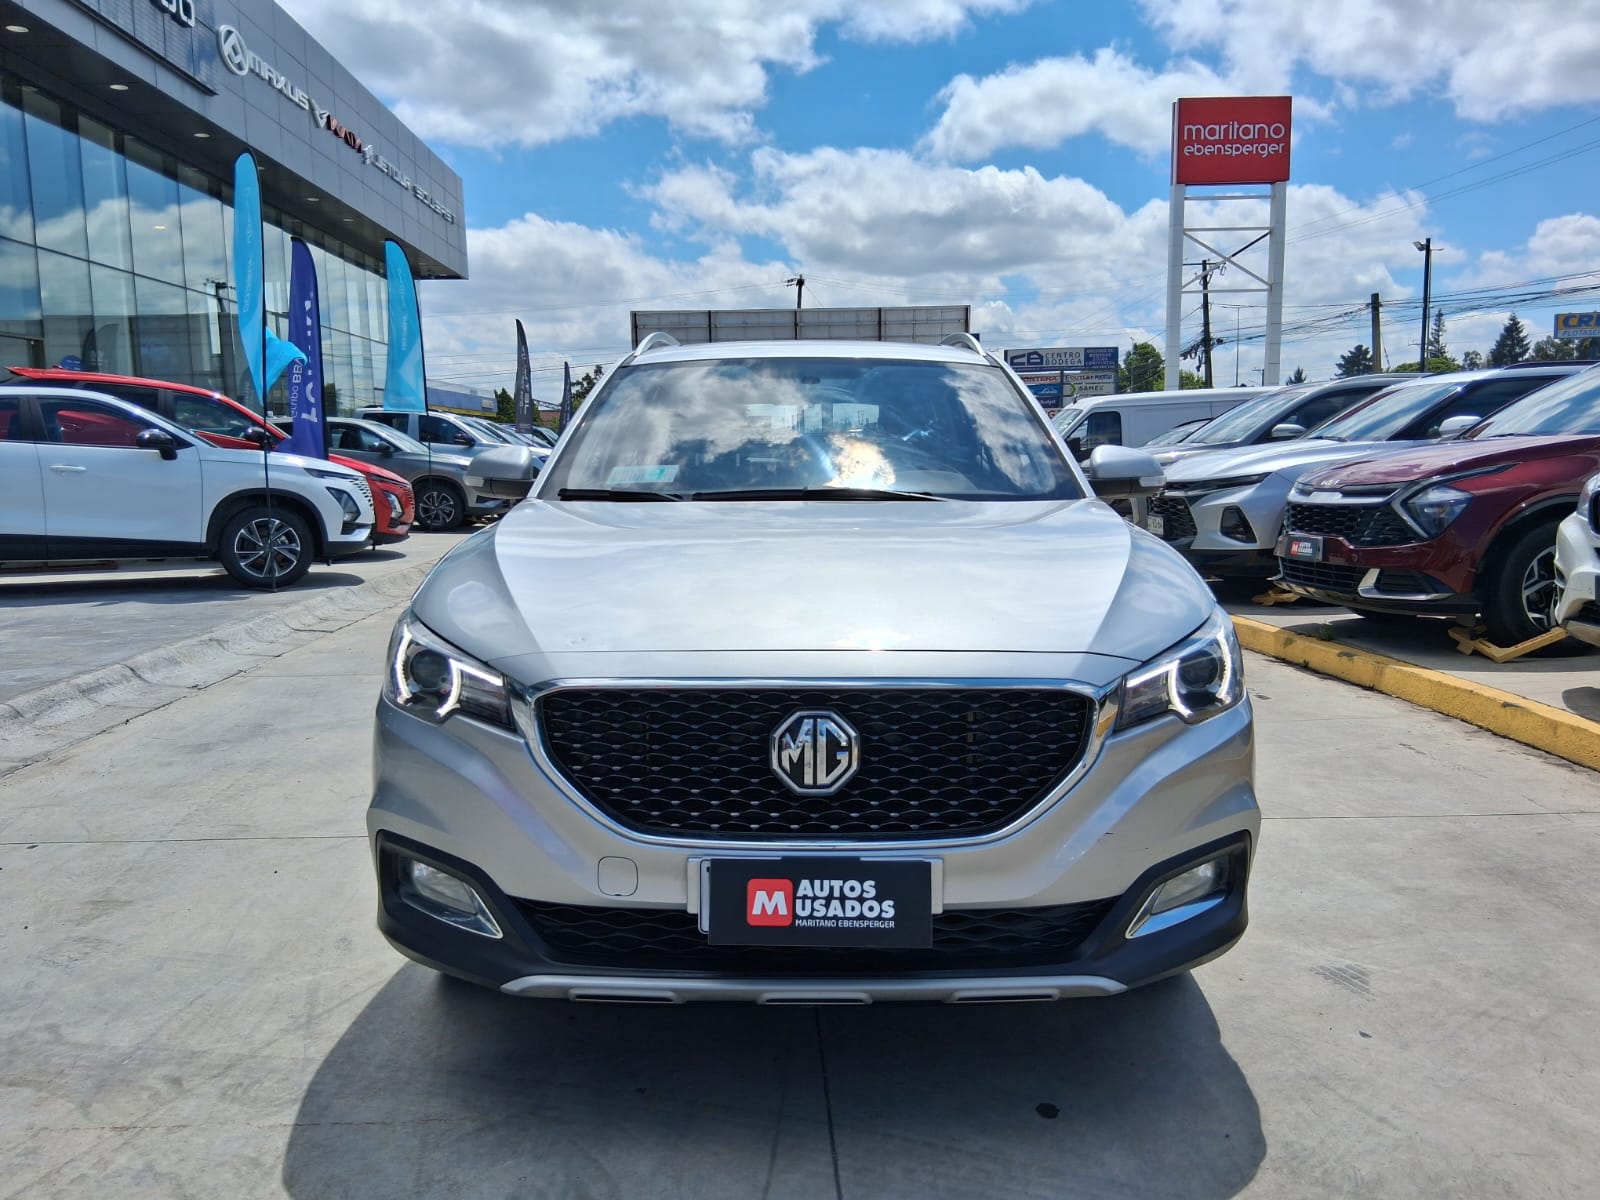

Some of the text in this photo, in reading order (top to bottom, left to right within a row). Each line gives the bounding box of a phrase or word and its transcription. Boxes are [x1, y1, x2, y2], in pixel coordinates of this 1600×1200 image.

[1184, 121, 1285, 140] maritano
[1184, 143, 1285, 158] ebensperger
[781, 718, 849, 785] MG
[796, 879, 876, 898] AUTOS
[795, 899, 895, 919] USADOS
[795, 919, 895, 929] MARITANO EBENSPERGER
